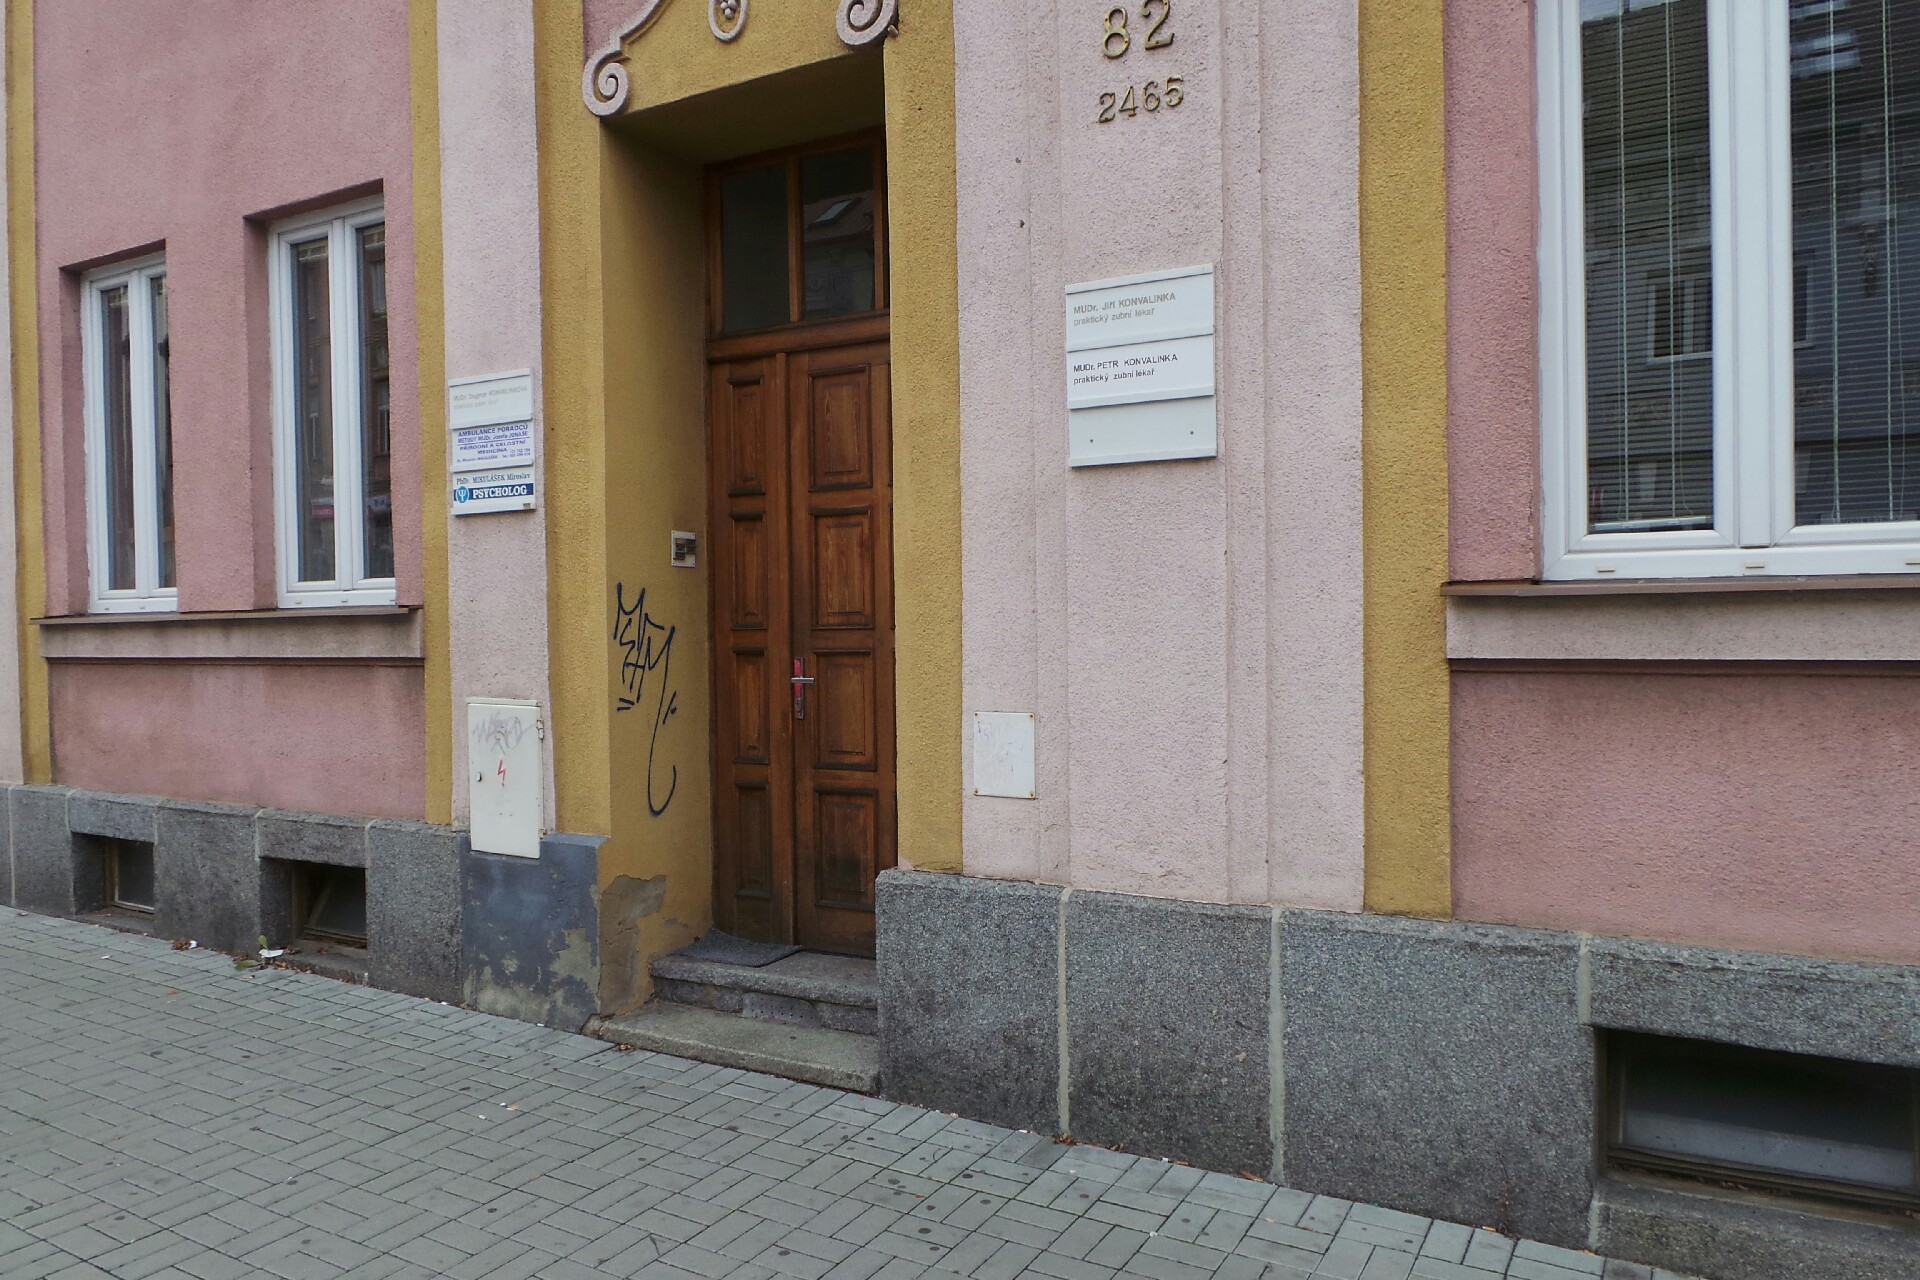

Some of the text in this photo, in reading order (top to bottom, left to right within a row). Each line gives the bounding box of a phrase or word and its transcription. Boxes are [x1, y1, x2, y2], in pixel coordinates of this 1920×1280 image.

[1103, 0, 1175, 59] 82
[1098, 75, 1184, 123] 2465
[1073, 292, 1176, 315] MUDr. Jiří KONVALINKA
[1073, 307, 1155, 327] praktický zubní lékař
[1073, 353, 1178, 373] MUDr. PETR KONVALINKA
[1073, 368, 1155, 386] praktický zubní lékař
[458, 423, 528, 437] AMBULANCE PORADCŮ
[472, 473, 505, 483] MIKULÁŠEK
[472, 485, 527, 499] PSYCHOLOG
